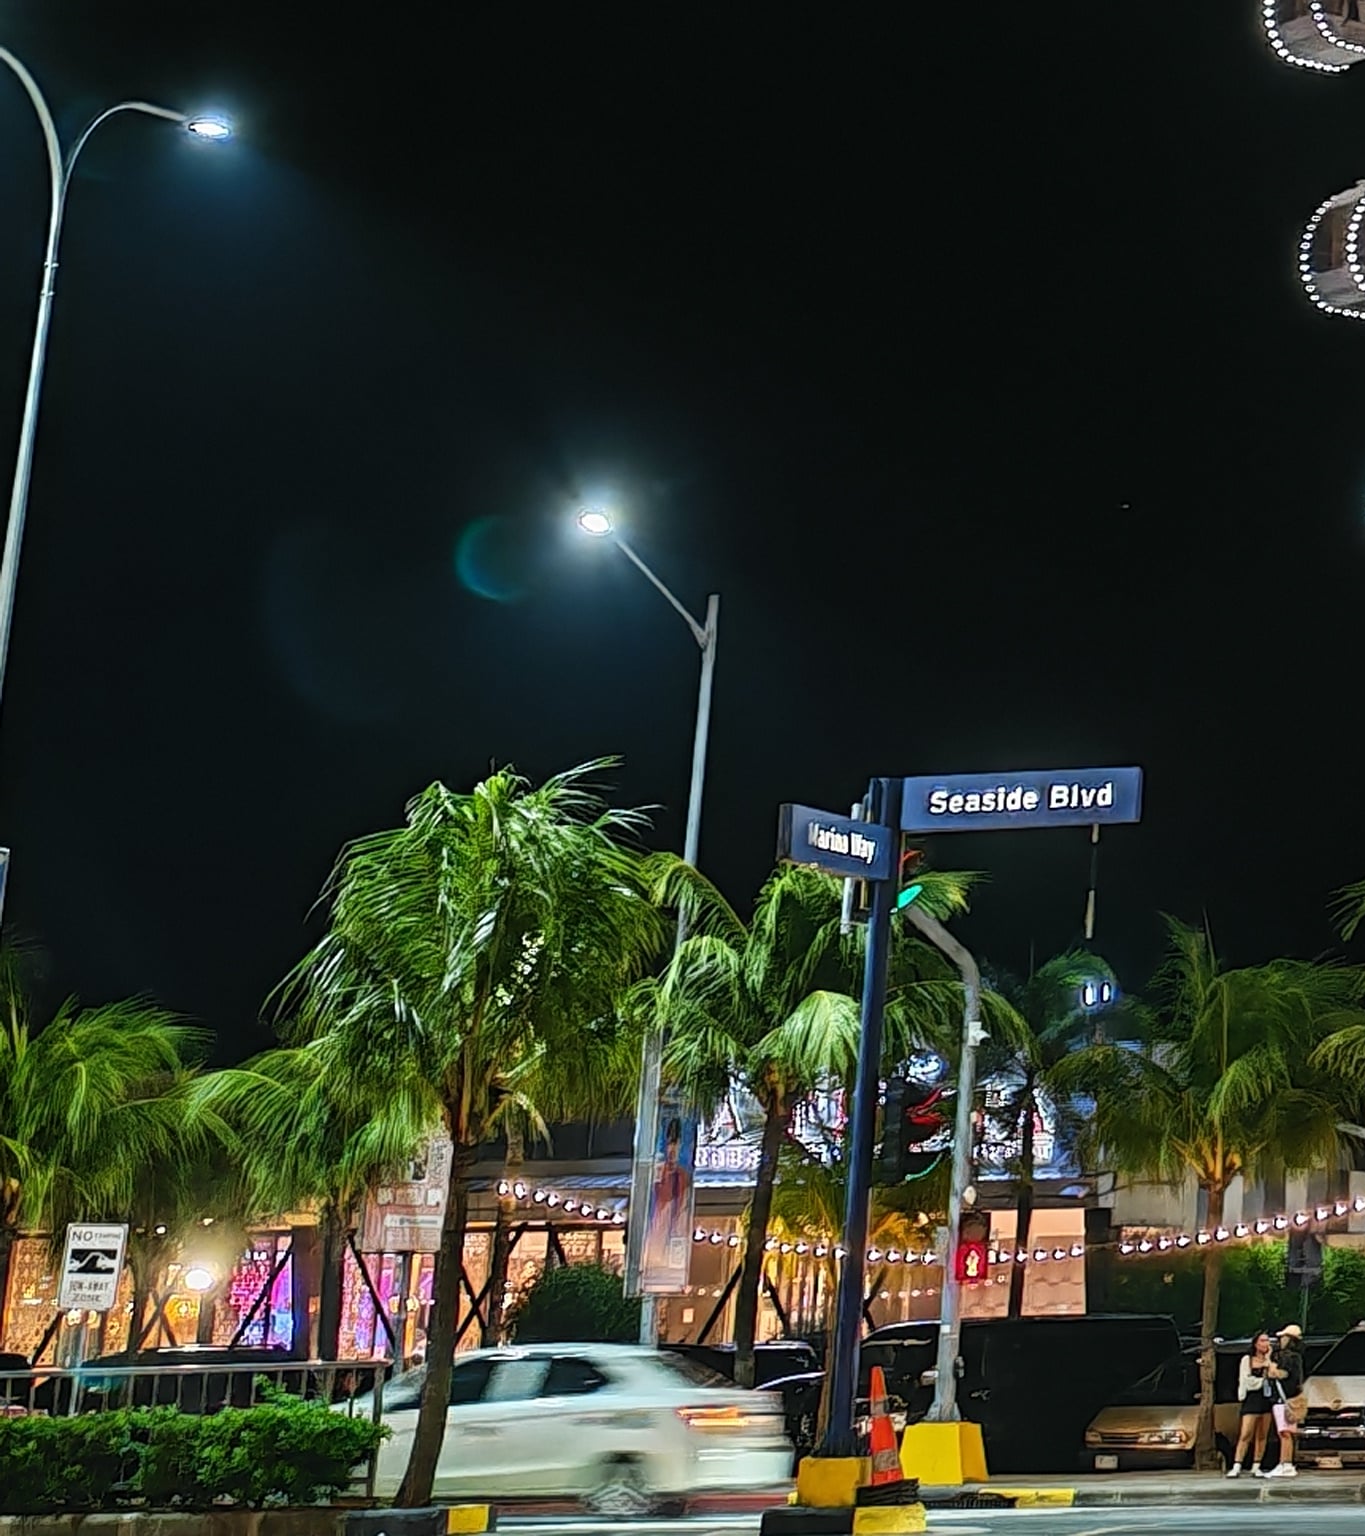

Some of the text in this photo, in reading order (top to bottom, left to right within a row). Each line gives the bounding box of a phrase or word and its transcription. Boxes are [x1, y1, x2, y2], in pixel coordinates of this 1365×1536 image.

[929, 781, 1114, 814] Seaside Blvd
[808, 821, 877, 864] Marina Way
[71, 1230, 94, 1242] NO
